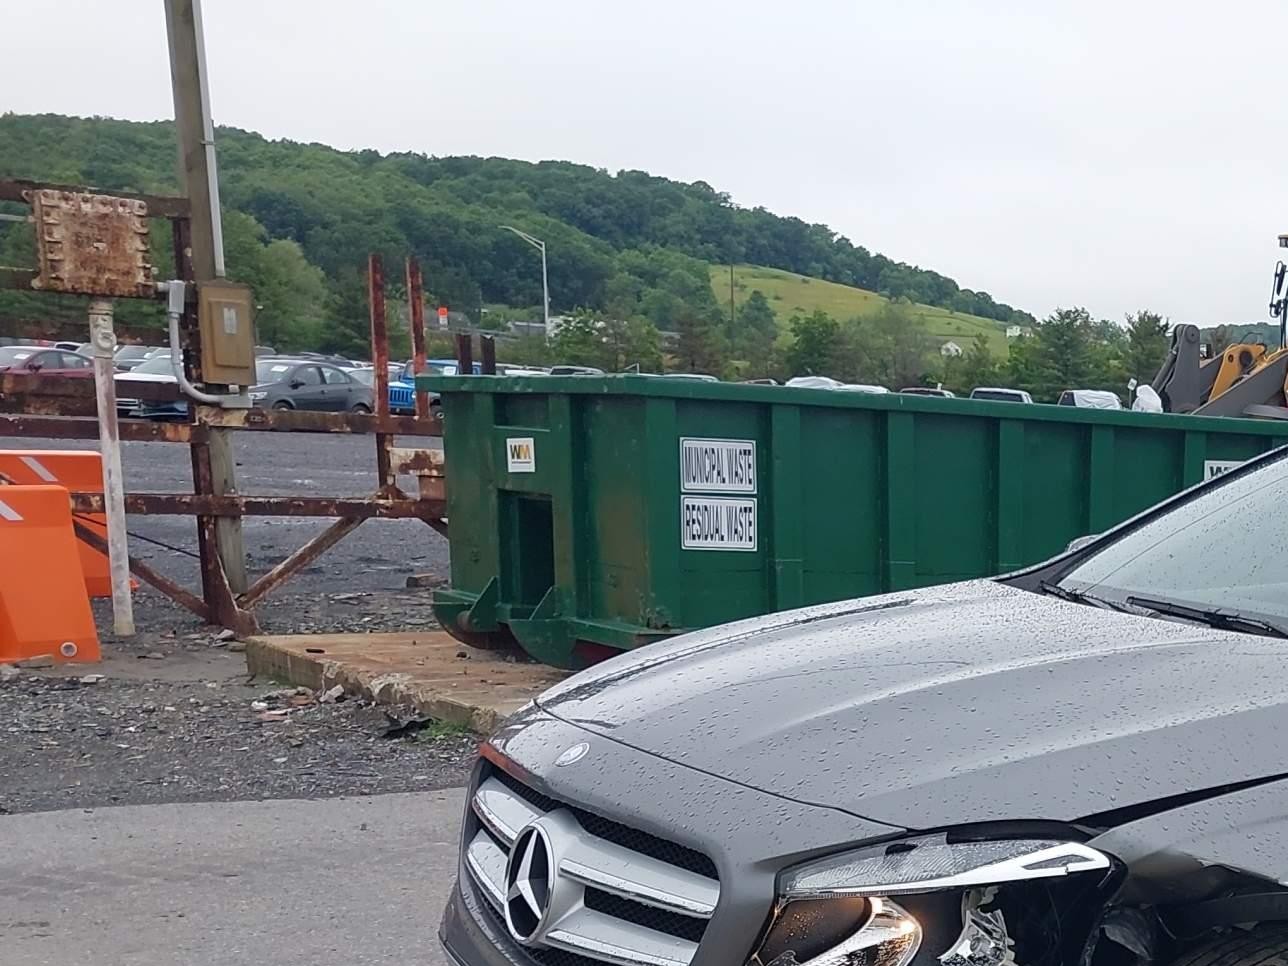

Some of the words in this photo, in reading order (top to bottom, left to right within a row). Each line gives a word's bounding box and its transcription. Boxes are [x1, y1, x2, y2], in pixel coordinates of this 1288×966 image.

[510, 444, 532, 460] WM
[684, 446, 726, 484] MUNICIPAL
[726, 447, 753, 485] WASTE
[685, 503, 725, 541] RESIDUAL
[726, 505, 753, 542] WASTE
